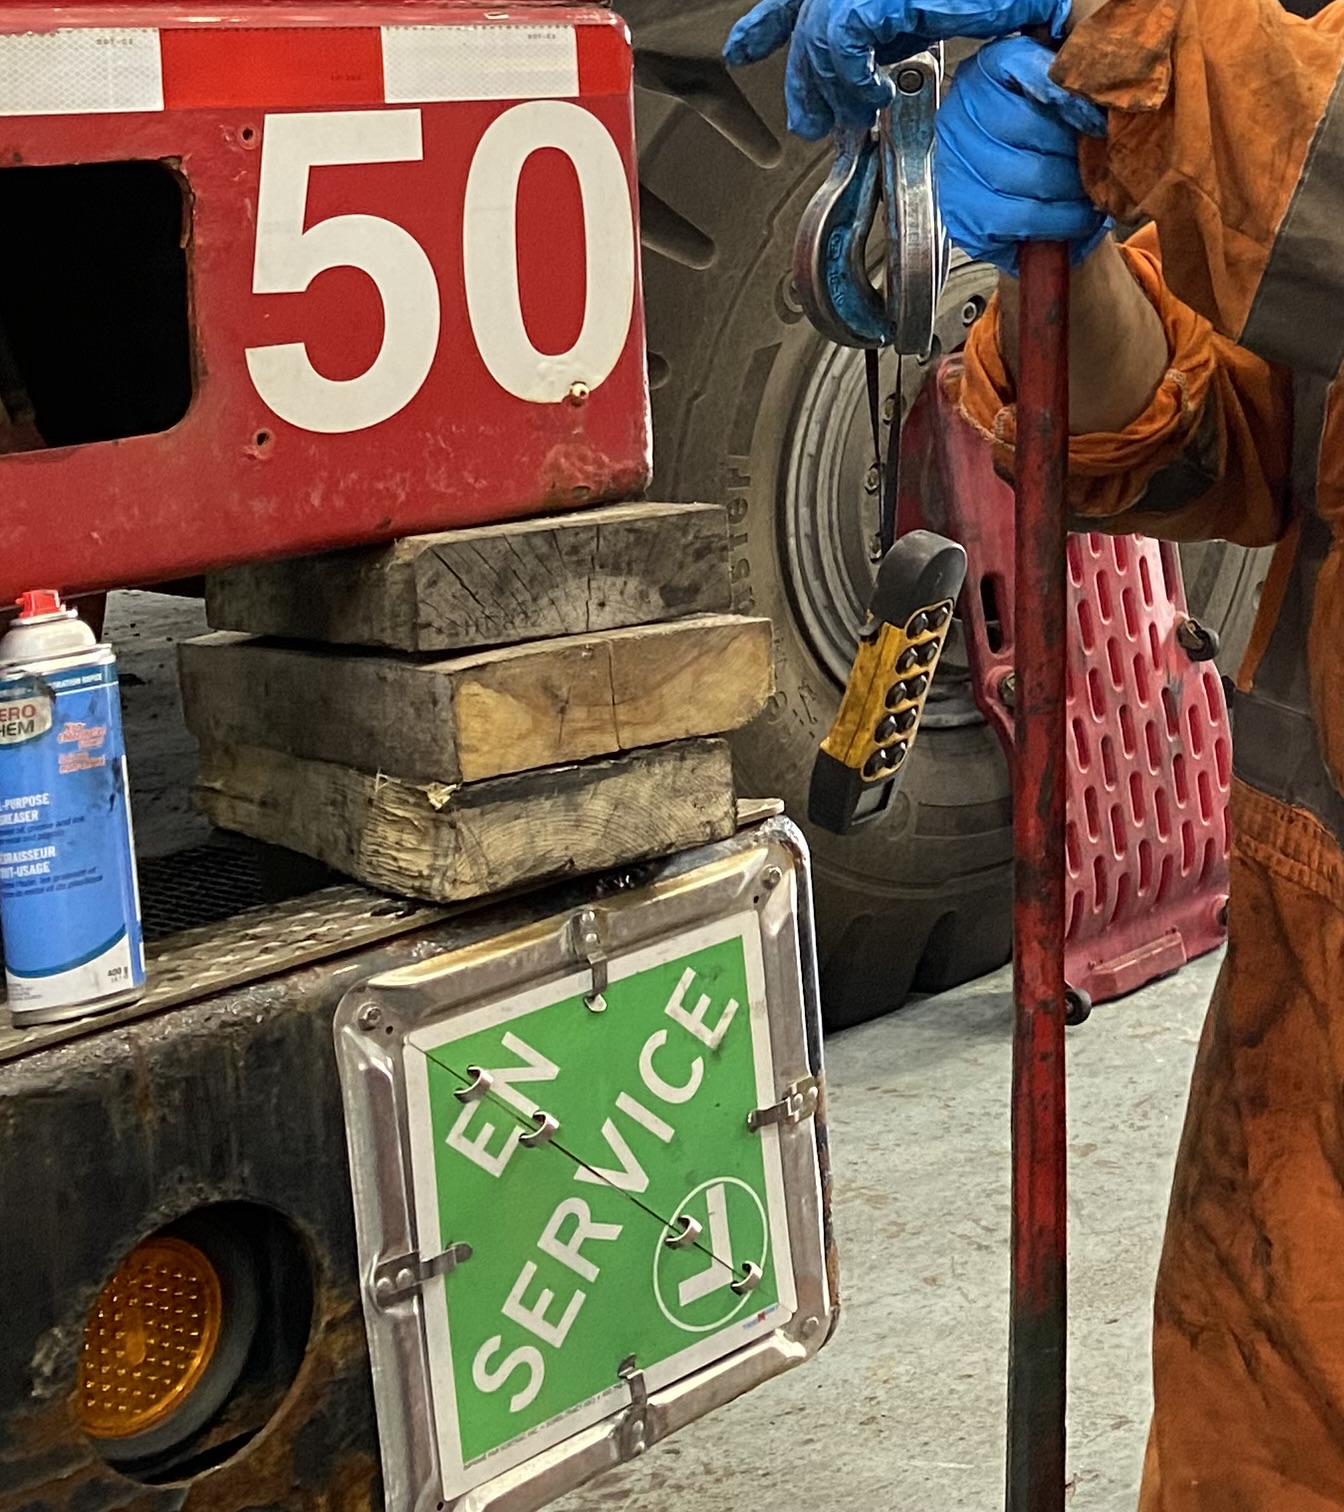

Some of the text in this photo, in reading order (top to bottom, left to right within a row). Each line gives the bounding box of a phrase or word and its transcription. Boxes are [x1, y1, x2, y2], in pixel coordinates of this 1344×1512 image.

[245, 100, 633, 434] 50
[0, 793, 49, 811] -PURPOSE
[445, 1031, 560, 1178] EN
[472, 966, 740, 1414] SERVICE
